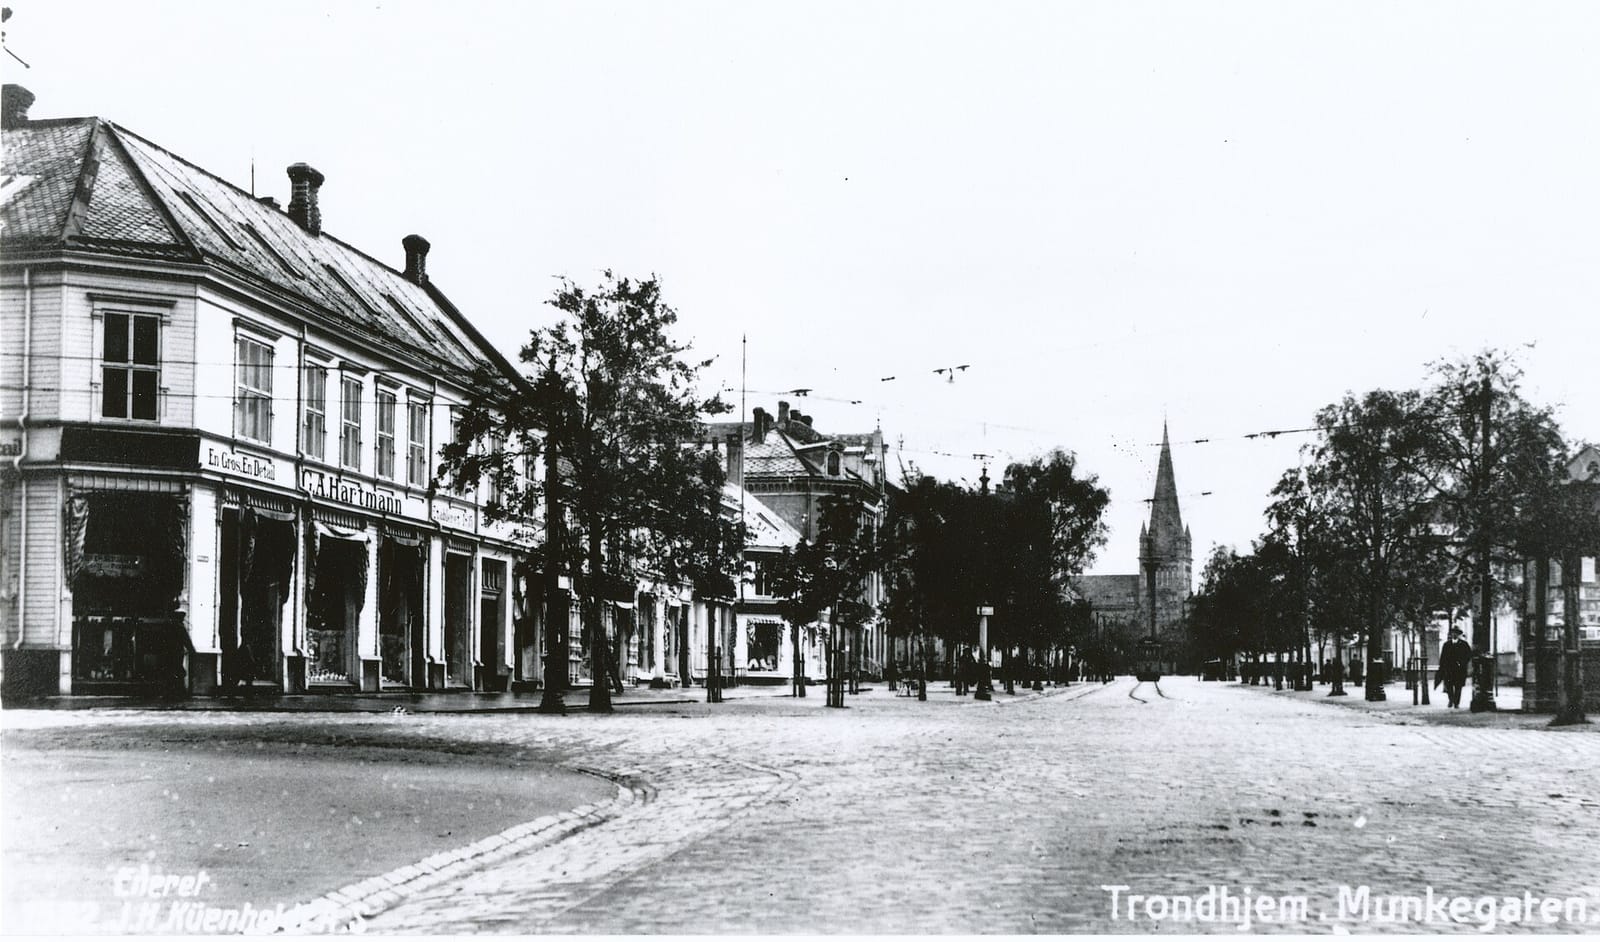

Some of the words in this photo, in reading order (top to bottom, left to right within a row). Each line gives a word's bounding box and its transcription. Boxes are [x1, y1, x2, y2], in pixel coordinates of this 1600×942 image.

[208, 448, 219, 467] En
[242, 456, 253, 475] En
[254, 459, 275, 481] Detail
